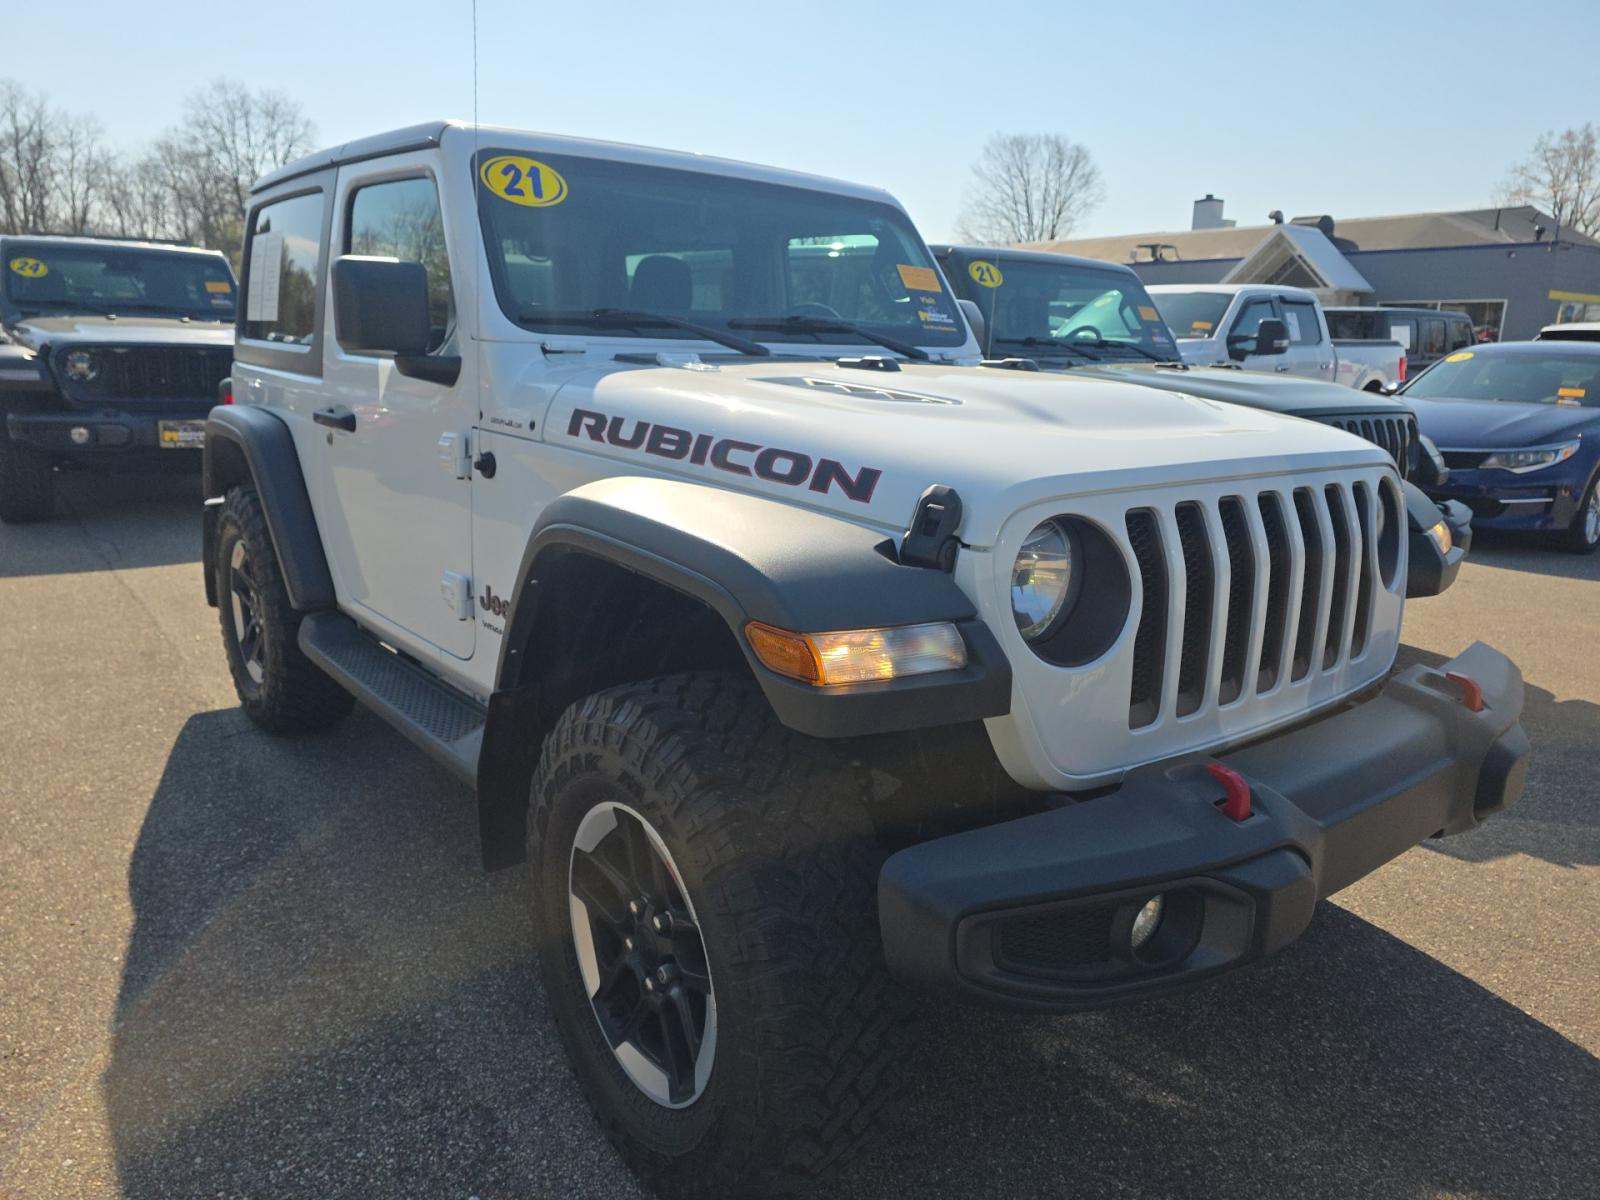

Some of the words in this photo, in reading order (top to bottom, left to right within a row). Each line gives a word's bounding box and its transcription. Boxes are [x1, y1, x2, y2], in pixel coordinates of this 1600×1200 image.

[501, 164, 543, 199] 21
[976, 265, 995, 283] 21
[567, 408, 883, 504] RUBICON
[479, 584, 511, 620] Jee
